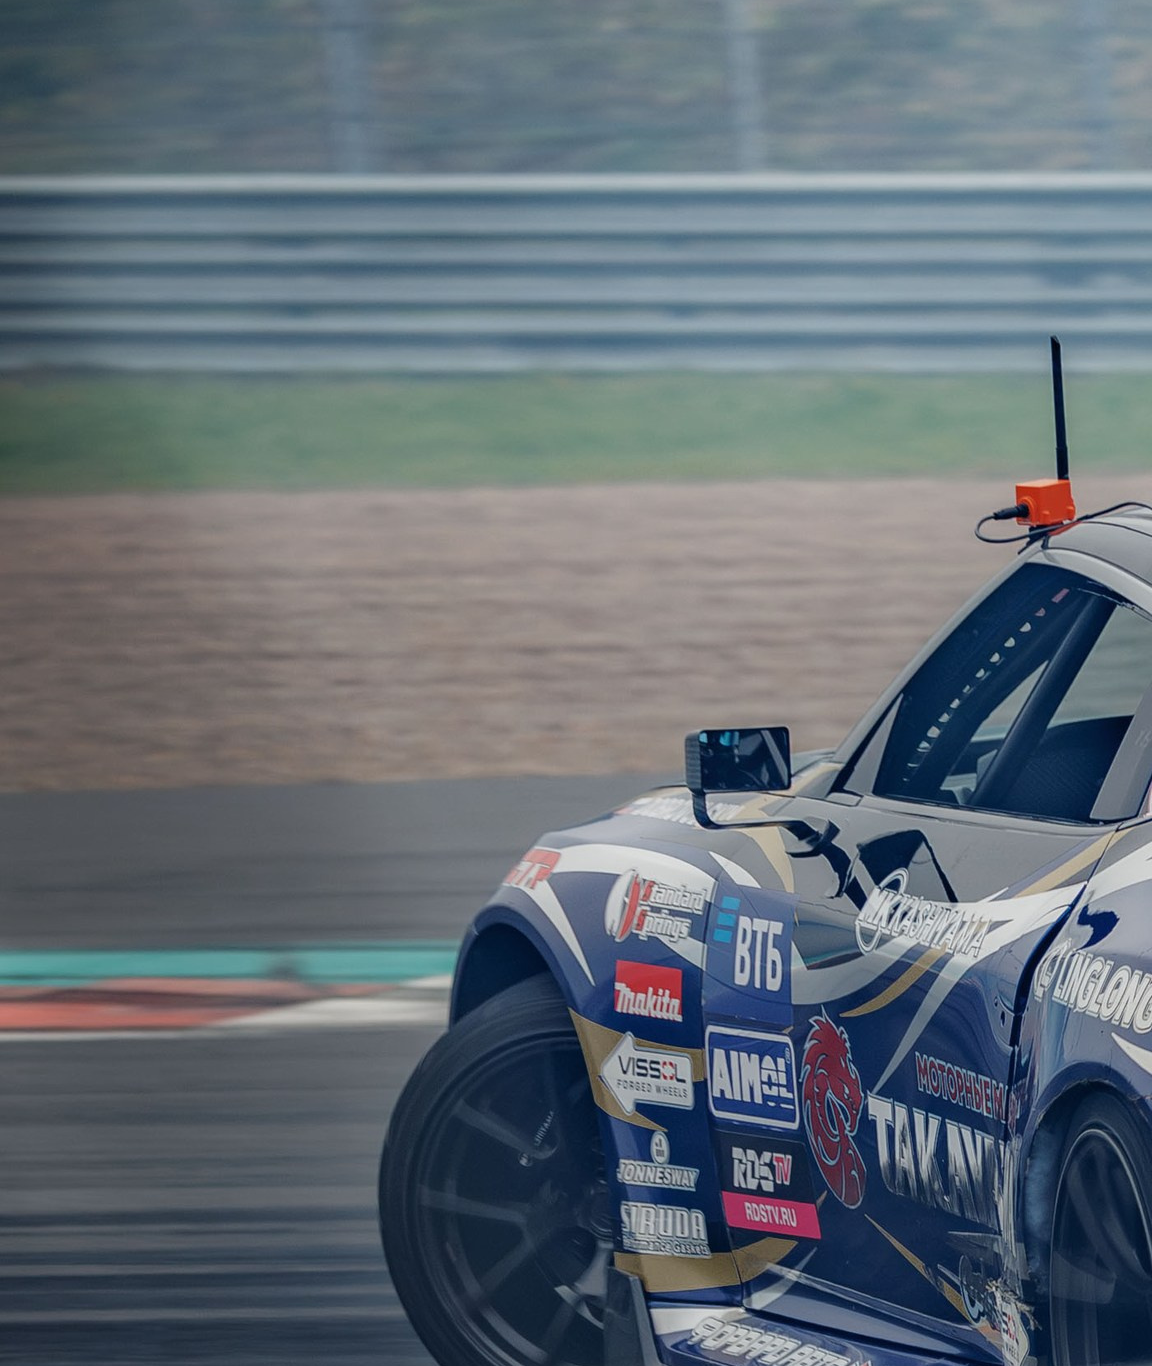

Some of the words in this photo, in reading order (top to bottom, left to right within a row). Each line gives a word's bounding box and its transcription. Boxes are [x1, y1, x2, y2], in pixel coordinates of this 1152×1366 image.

[642, 879, 706, 914] Standard
[634, 907, 691, 942] Springs
[733, 915, 784, 993] ВТБ
[617, 1055, 687, 1084] VISSOL
[712, 1048, 796, 1110] AIMOL
[914, 1050, 993, 1120] МОТОРНЫЕ
[616, 1079, 652, 1094] FORGED
[655, 1085, 689, 1099] WHEELS
[616, 1159, 699, 1192] JONNESWAY
[620, 1201, 707, 1242] SIRUDA
[744, 1201, 798, 1228] RDSTV.RU
